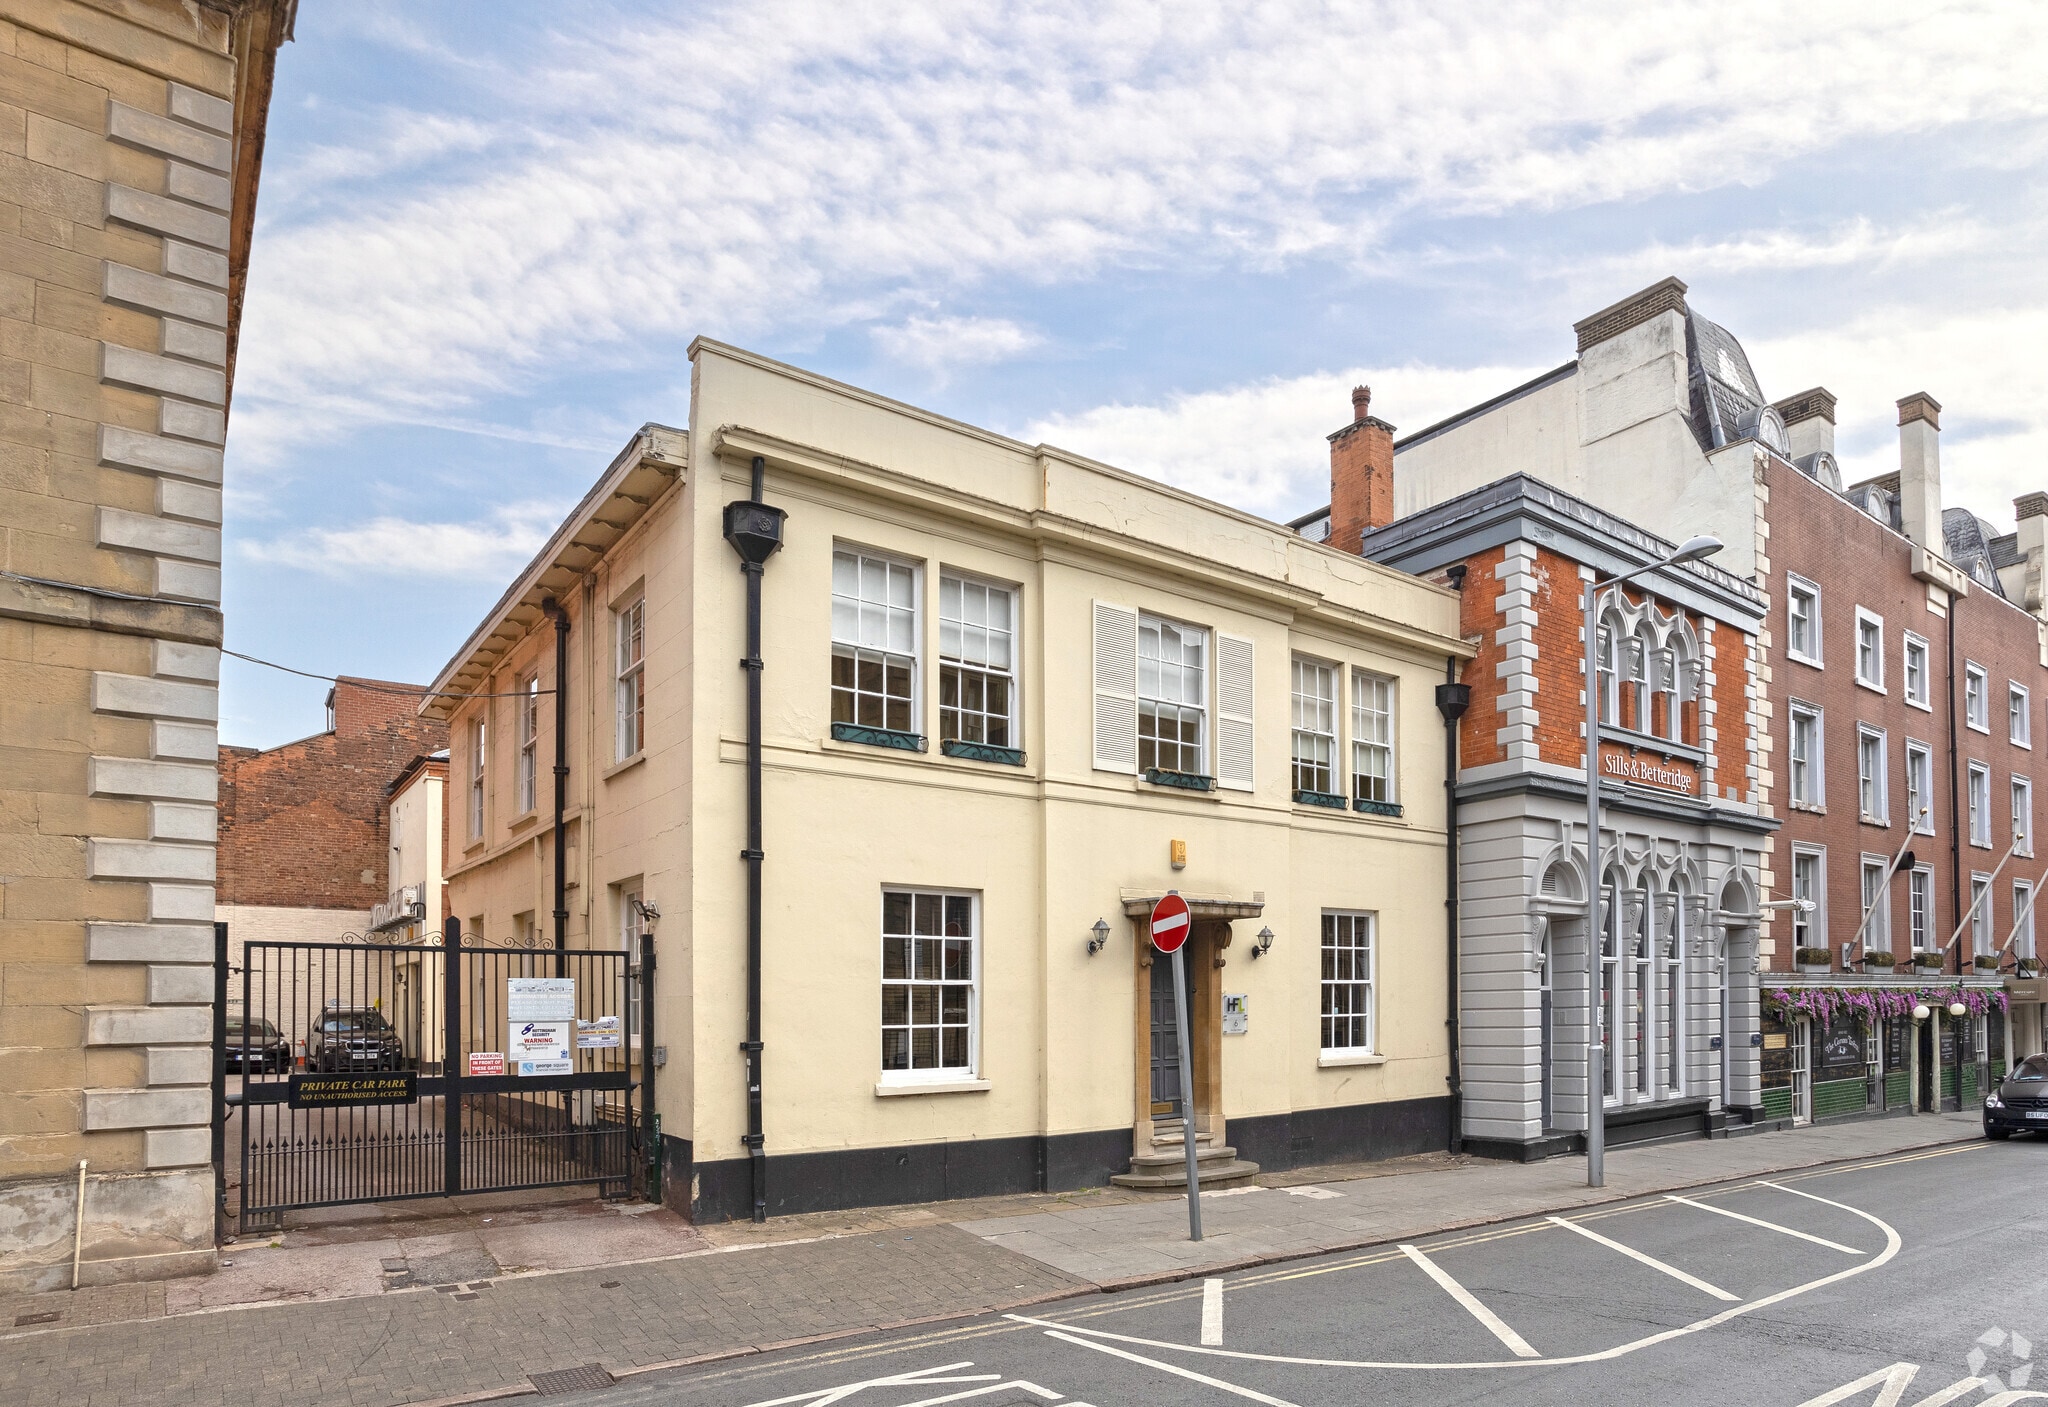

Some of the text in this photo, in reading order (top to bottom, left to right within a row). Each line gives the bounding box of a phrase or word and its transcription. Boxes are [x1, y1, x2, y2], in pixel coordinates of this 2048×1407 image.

[1605, 753, 1691, 792] Sills & Betteridge
[1227, 997, 1245, 1012] HFL
[300, 1079, 407, 1091] PRIVATE CAR PARK
[314, 1091, 376, 1100] UNAUTHORISED
[378, 1090, 407, 1098] ACCESS
